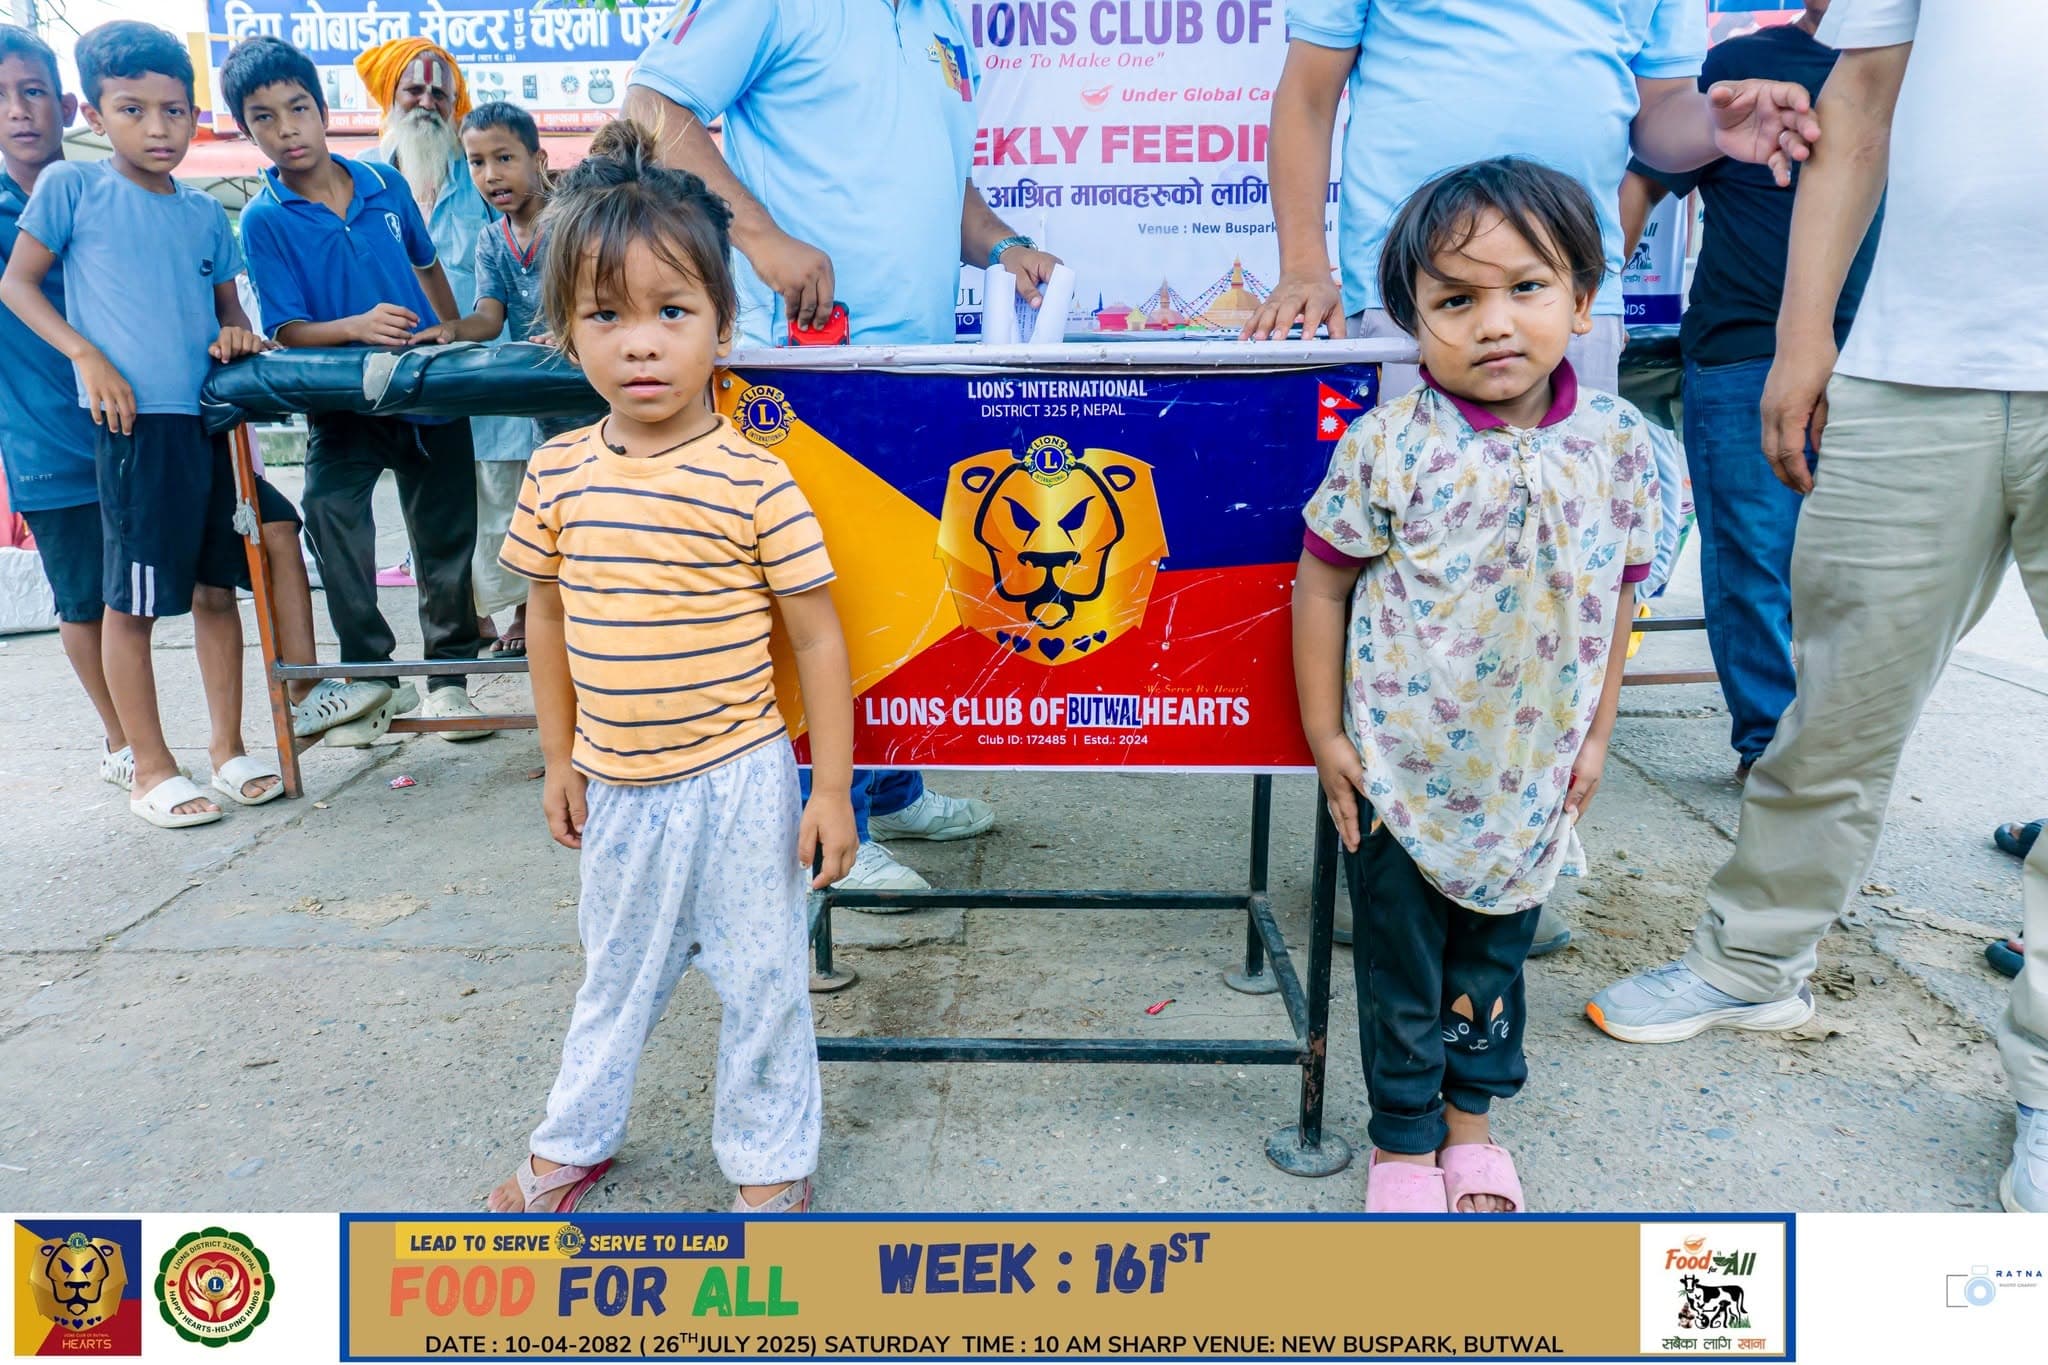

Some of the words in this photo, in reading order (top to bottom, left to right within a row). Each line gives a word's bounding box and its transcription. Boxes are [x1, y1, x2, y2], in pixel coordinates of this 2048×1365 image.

[290, 0, 411, 51] मोबाईल
[418, 0, 511, 50] सेन्टर
[529, 0, 610, 51] चश्मा
[619, 6, 672, 47] पस
[971, 1, 1078, 48] IONS
[1090, 0, 1201, 44] CLUB
[1217, 0, 1272, 44] OF
[985, 54, 1023, 70] One
[1030, 53, 1051, 68] To
[1058, 51, 1112, 68] Make
[1117, 51, 1165, 68] One"
[1122, 87, 1178, 102] Under
[1184, 87, 1243, 102] Global
[972, 126, 1088, 166] EKLY
[986, 178, 1063, 209] आश्रित
[1210, 175, 1268, 206] लागि
[1137, 223, 1179, 234] Venue
[1192, 222, 1221, 233] New
[745, 387, 782, 400] LIONS
[967, 381, 1015, 399] LIONS
[1022, 380, 1148, 399] INTERNATIONAL
[758, 404, 775, 425] L
[981, 404, 1040, 418] DISTRICT
[1043, 403, 1068, 418] 325
[1071, 403, 1080, 418] P,
[1083, 403, 1126, 417] NEPAL
[1033, 436, 1066, 449] LIONS
[1043, 450, 1058, 469] L
[865, 696, 947, 727] LIONS
[951, 696, 1022, 727] CLUB
[1029, 696, 1065, 726] OF
[1068, 694, 1142, 727] BUTWAL
[1142, 696, 1250, 727] HEARTS
[977, 734, 1004, 746] Club
[1007, 734, 1024, 746] ID:
[1026, 734, 1068, 746] 172485
[1119, 734, 1149, 746] 2024
